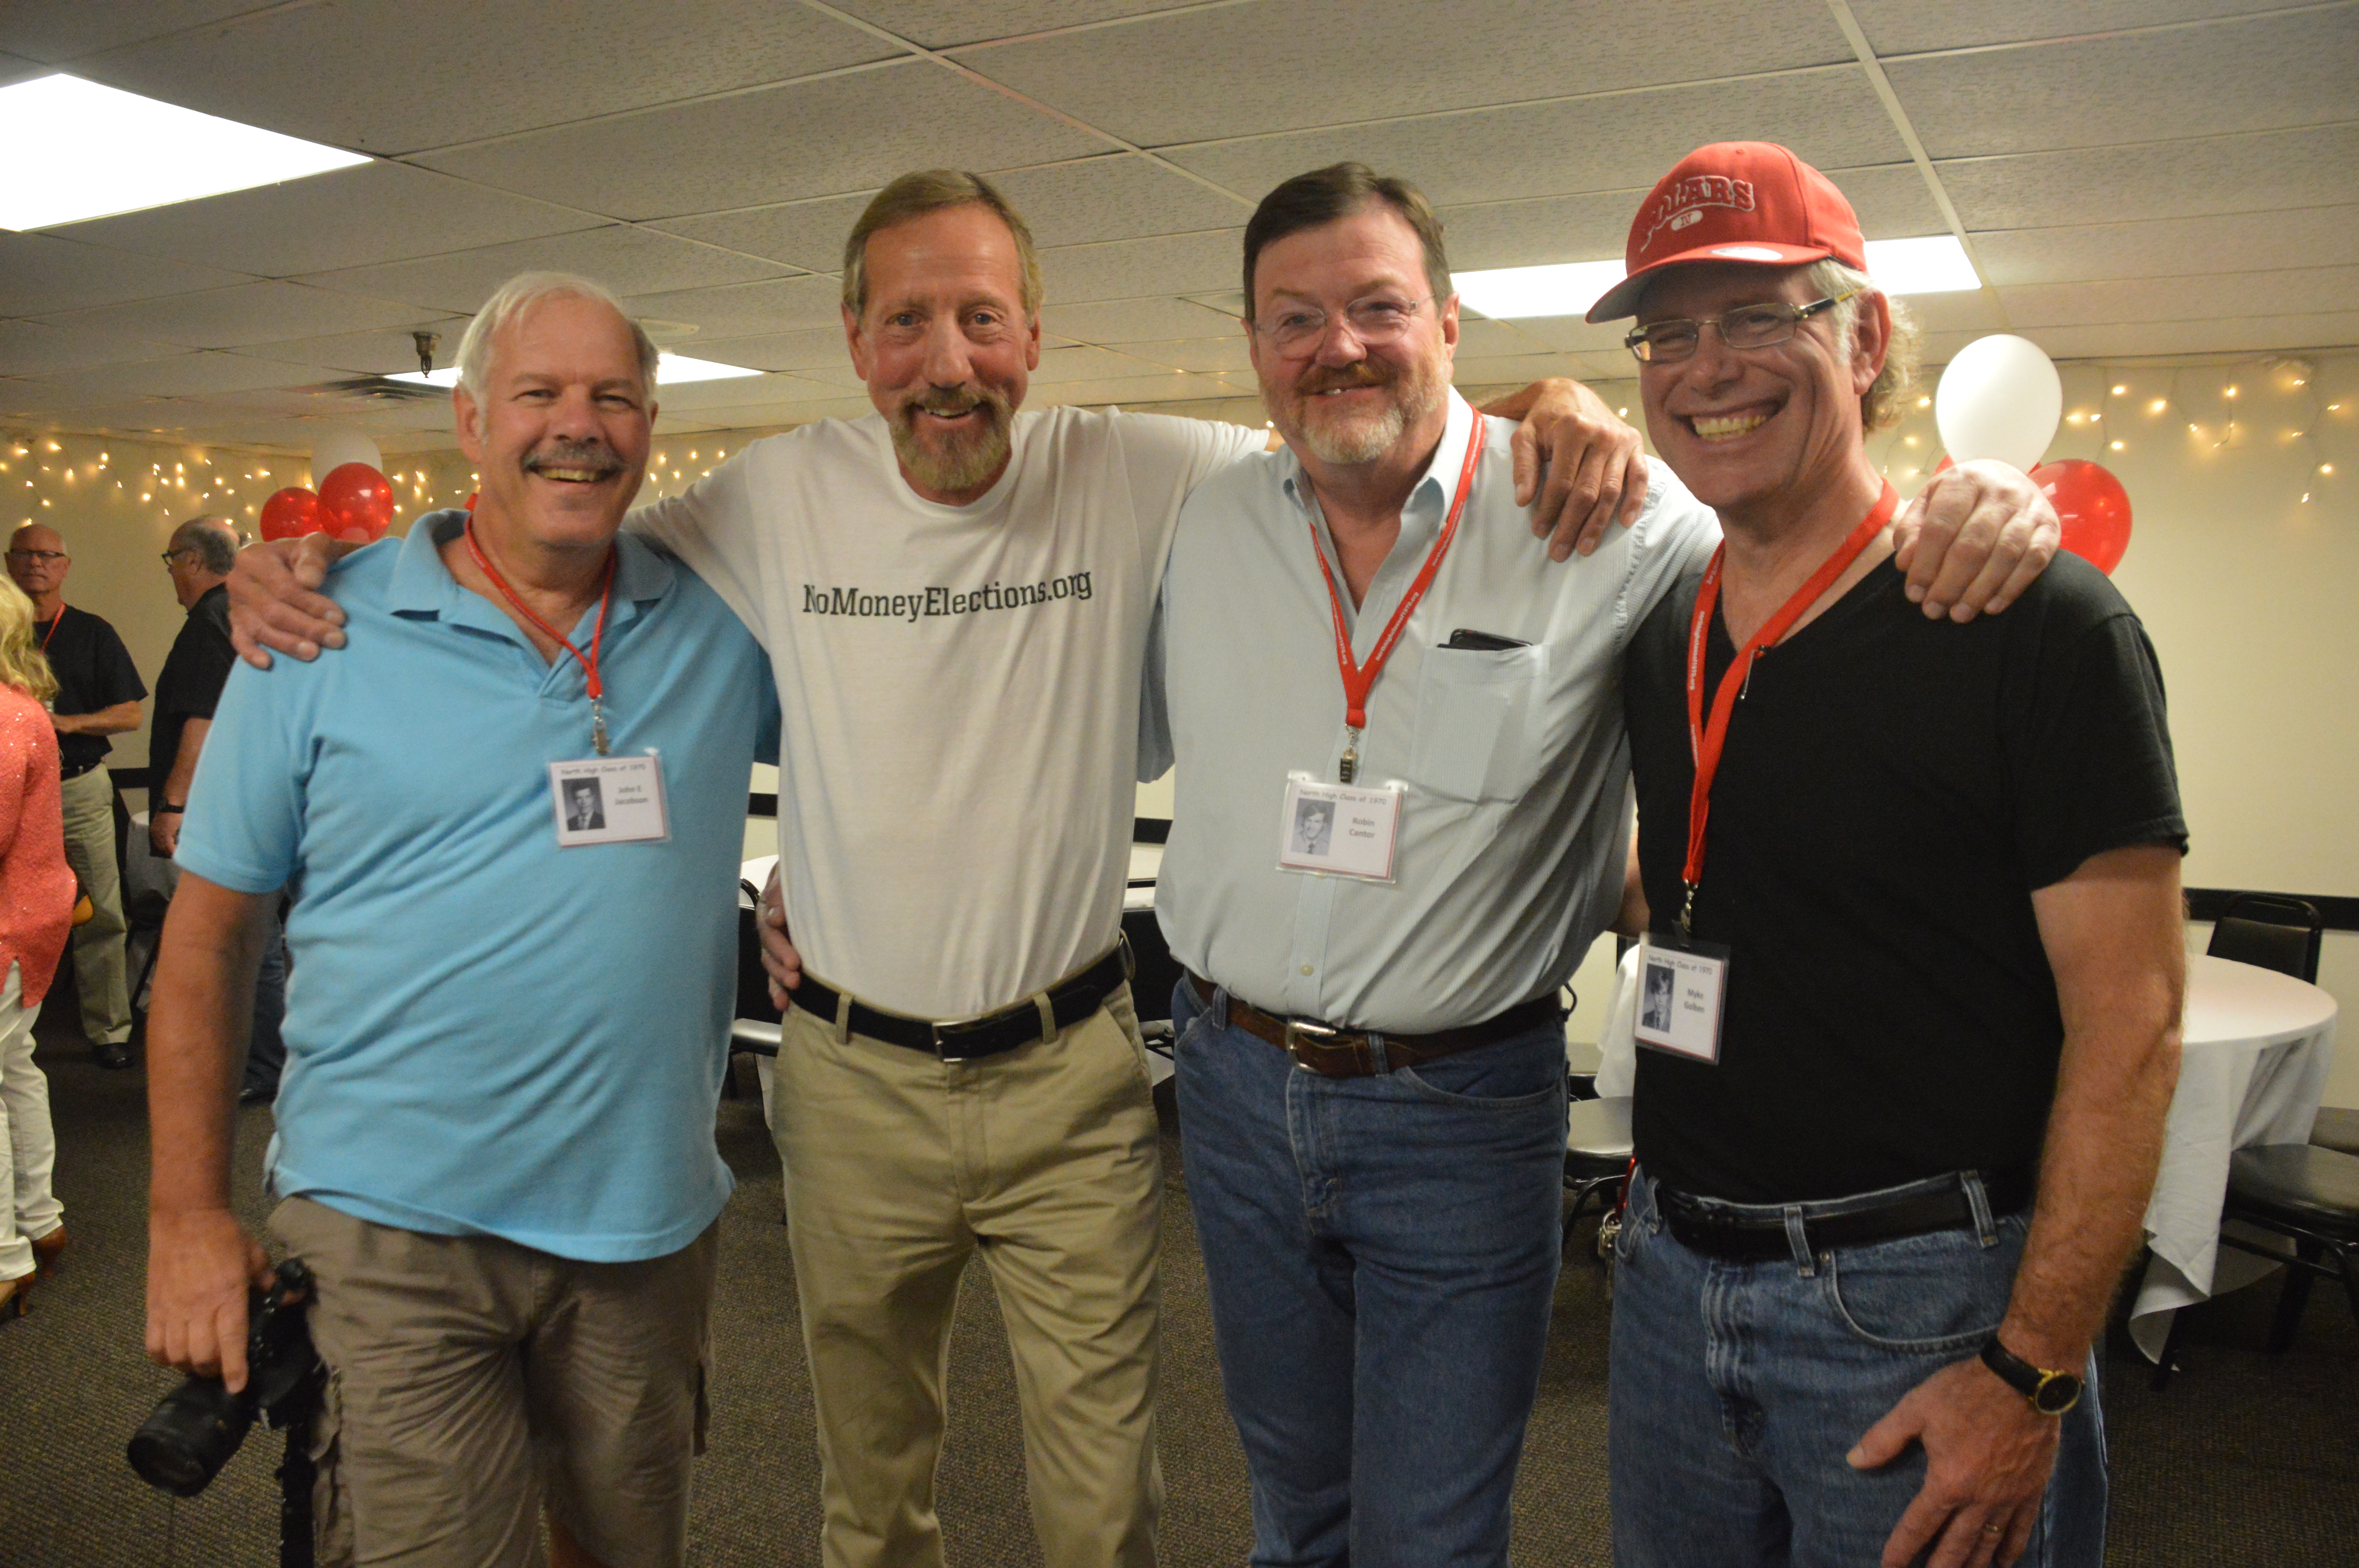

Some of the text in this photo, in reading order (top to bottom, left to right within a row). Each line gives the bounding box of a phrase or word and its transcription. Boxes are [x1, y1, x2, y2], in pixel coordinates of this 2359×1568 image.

[803, 572, 1093, 622] NoMoneyElections.org
[1339, 793, 1356, 801] Class
[1369, 797, 1387, 805] 1970
[1353, 817, 1375, 827] Robin
[1349, 828, 1376, 838] Cantor
